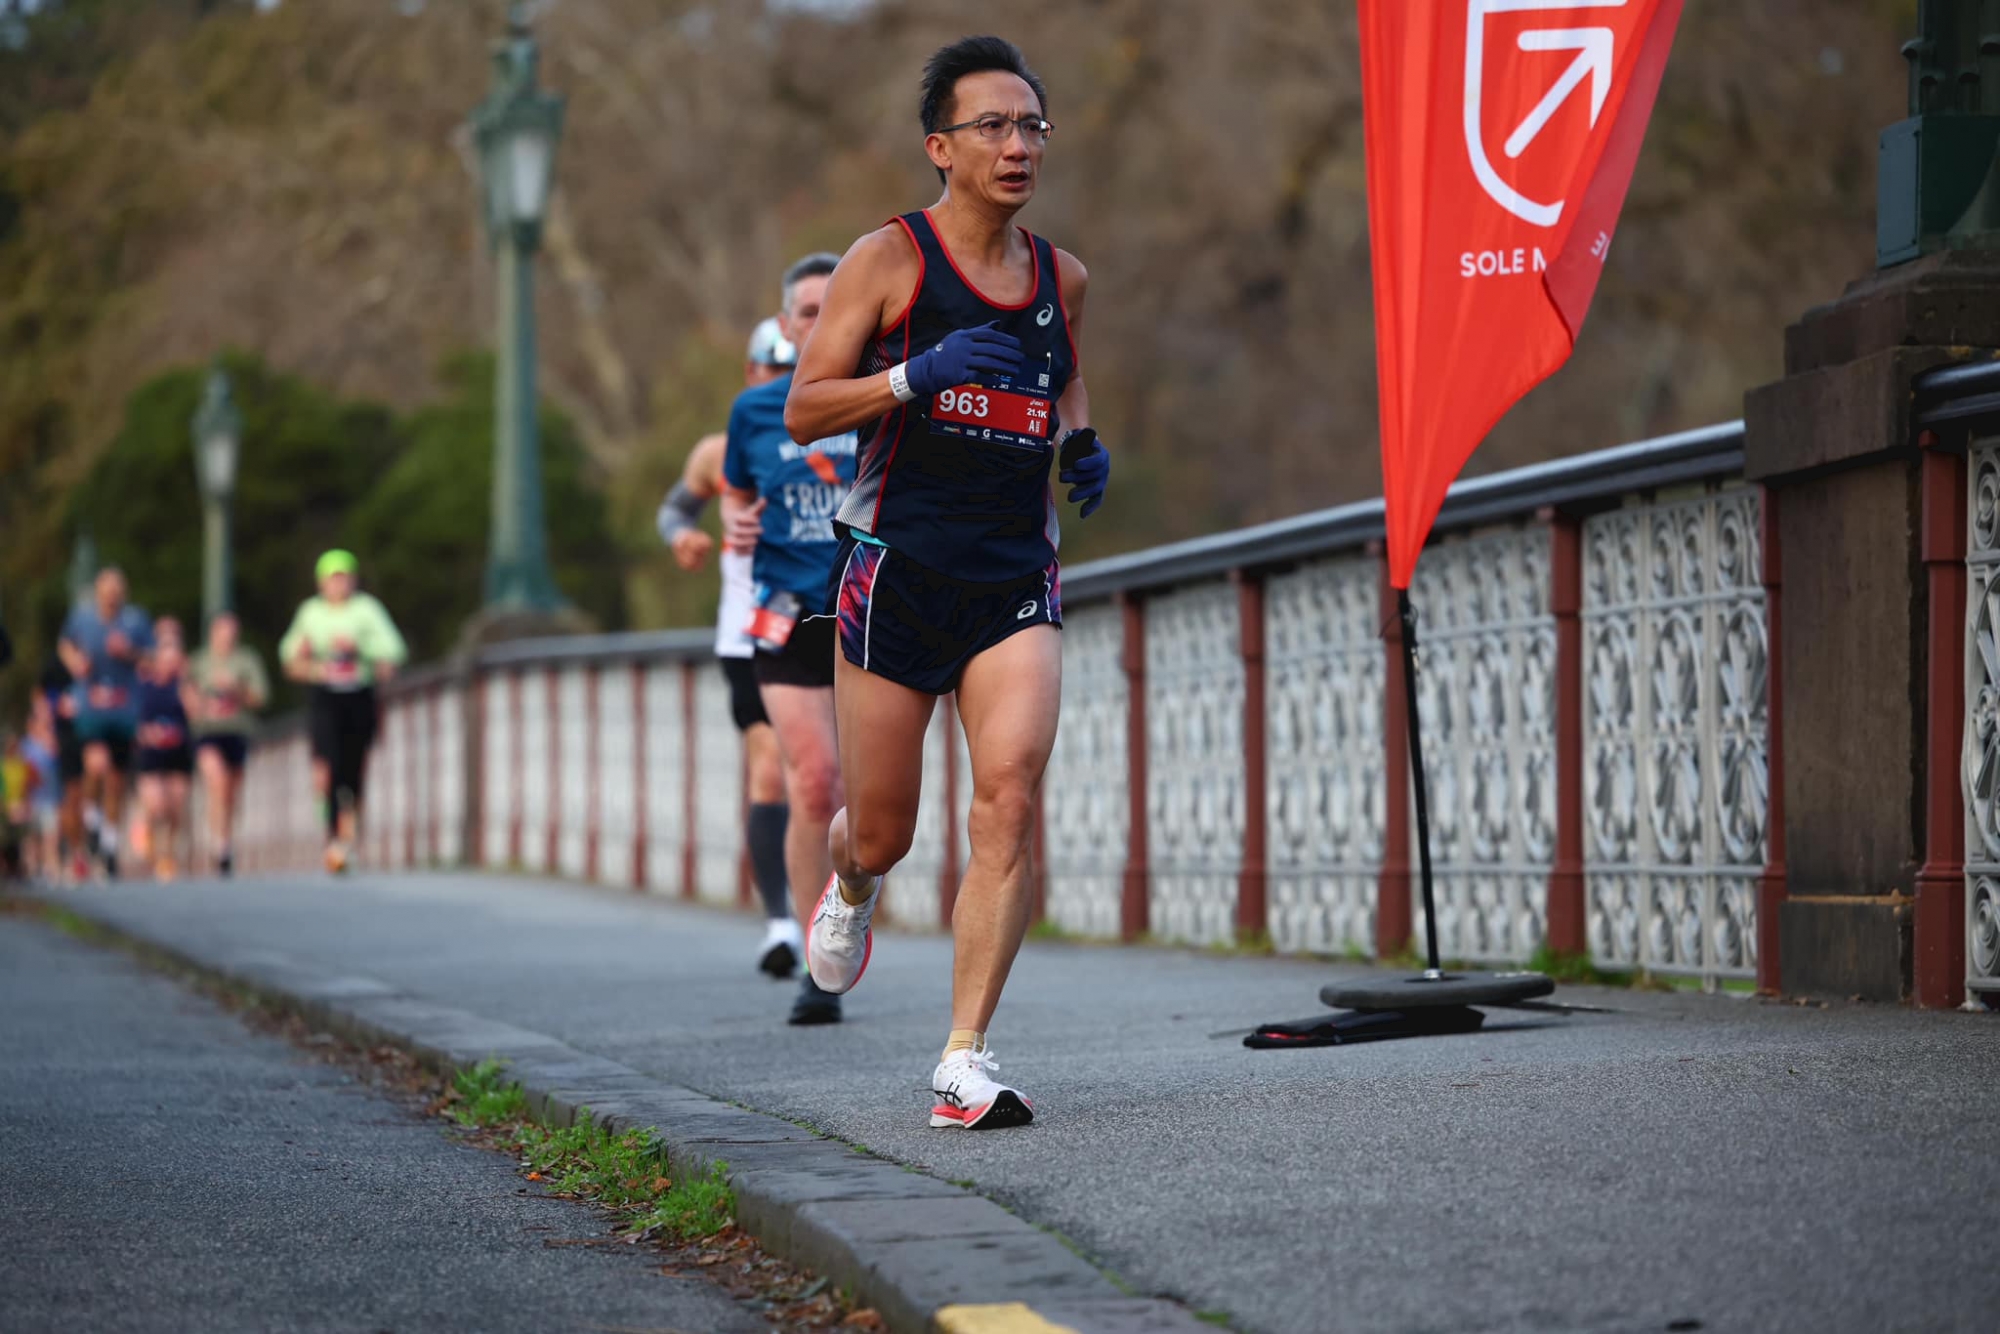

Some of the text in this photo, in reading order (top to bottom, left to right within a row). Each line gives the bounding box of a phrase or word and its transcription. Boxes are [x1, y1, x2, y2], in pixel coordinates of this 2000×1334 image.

[1460, 248, 1526, 278] SOLE
[939, 389, 989, 418] 963
[1026, 407, 1047, 419] 21.1K
